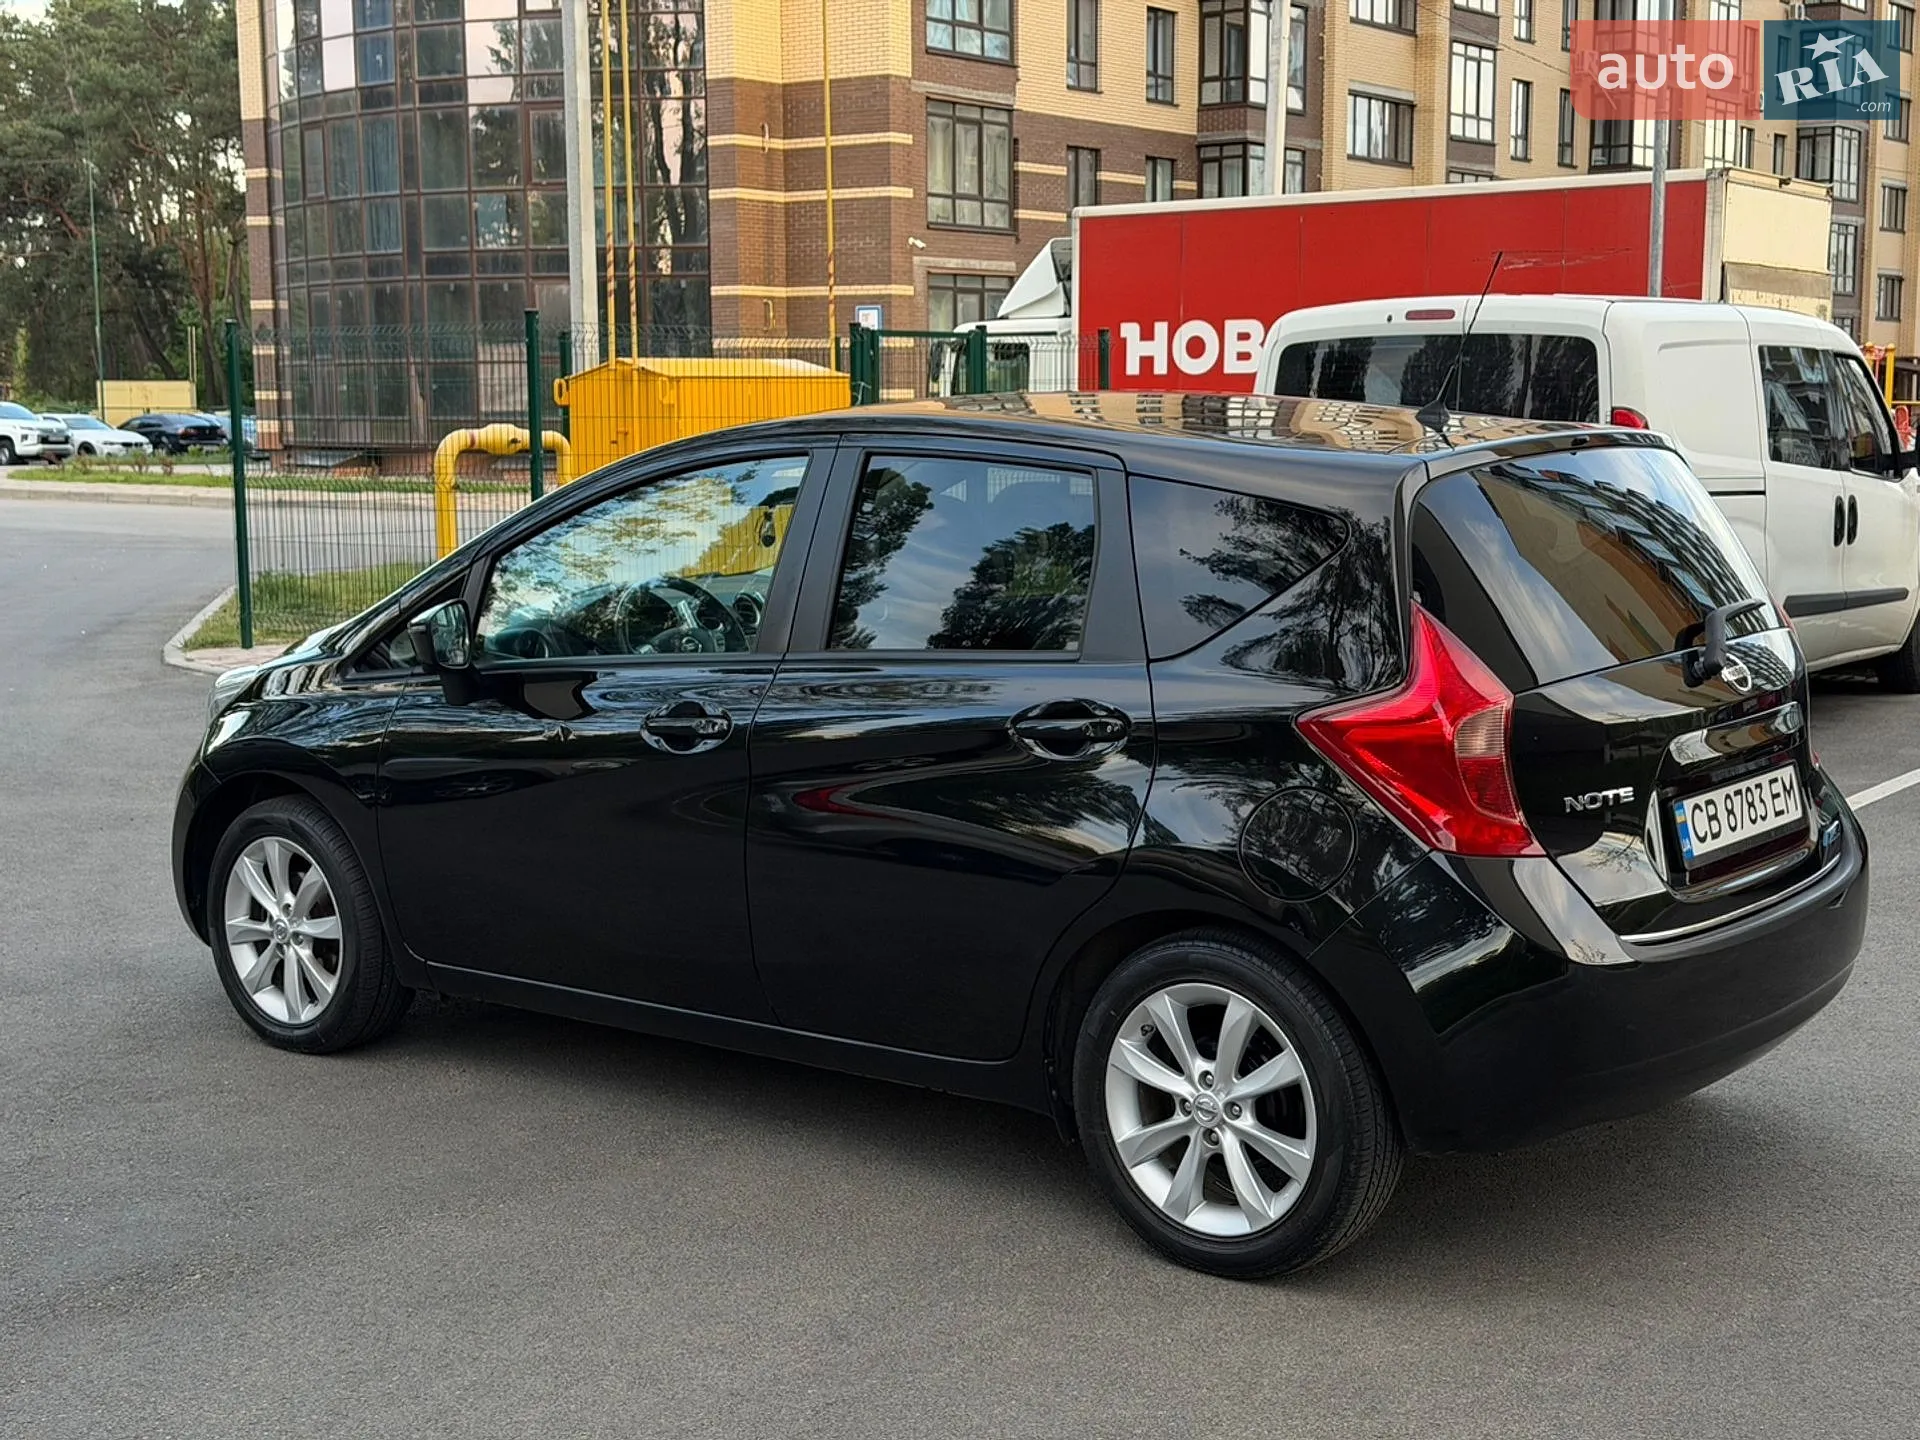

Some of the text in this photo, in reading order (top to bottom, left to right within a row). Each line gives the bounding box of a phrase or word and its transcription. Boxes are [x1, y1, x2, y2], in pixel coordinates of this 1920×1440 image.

[1563, 786, 1635, 813] NOTE
[1691, 772, 1799, 844] CB 8783 EM
